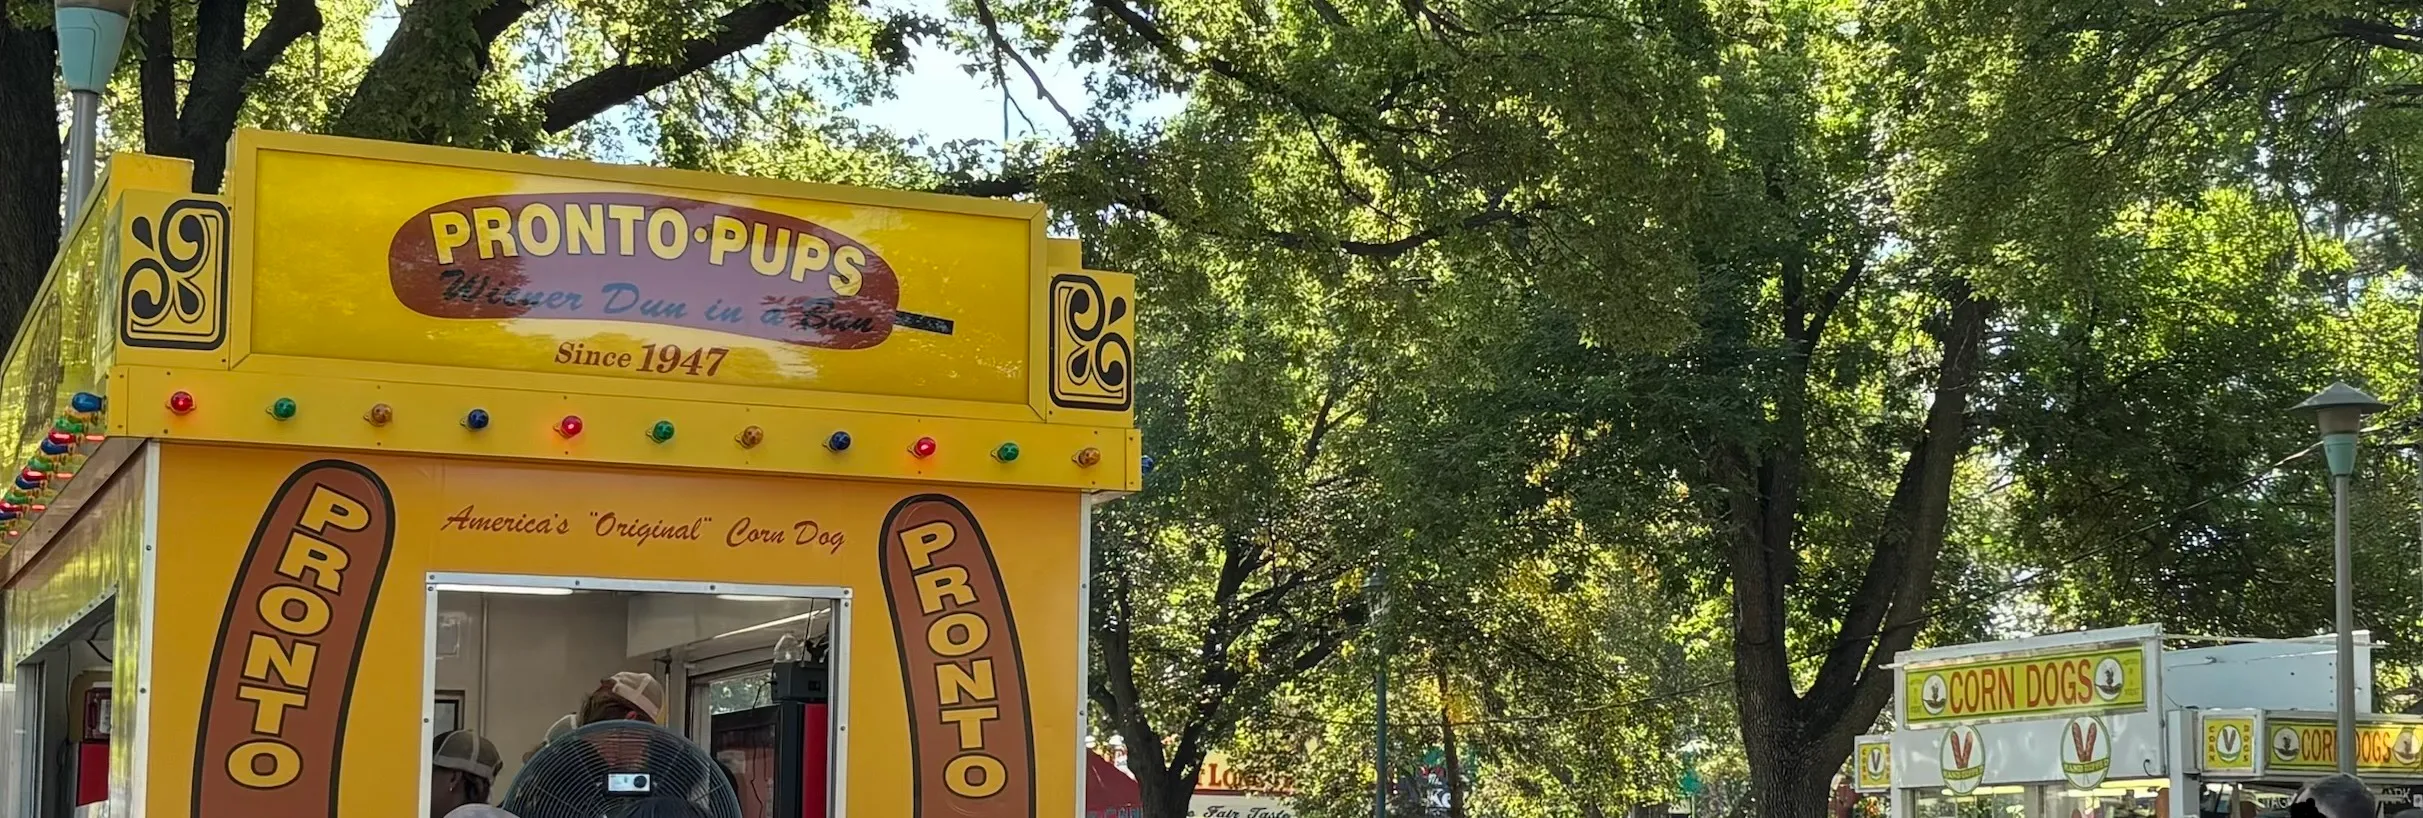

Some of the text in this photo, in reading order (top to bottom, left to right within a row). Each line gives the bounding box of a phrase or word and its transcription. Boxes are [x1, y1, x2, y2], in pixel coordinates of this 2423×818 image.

[438, 269, 584, 311] Wiener
[601, 282, 688, 319] Dun
[704, 299, 744, 323] in
[760, 309, 785, 326] a
[554, 341, 730, 377] Since 1947
[440, 504, 846, 554] America's "Original" Corn Dog
[225, 483, 373, 790] PRONTO
[898, 520, 1009, 799] PRONTO
[1950, 667, 2015, 714] CORN
[2026, 659, 2094, 708] DOGS
